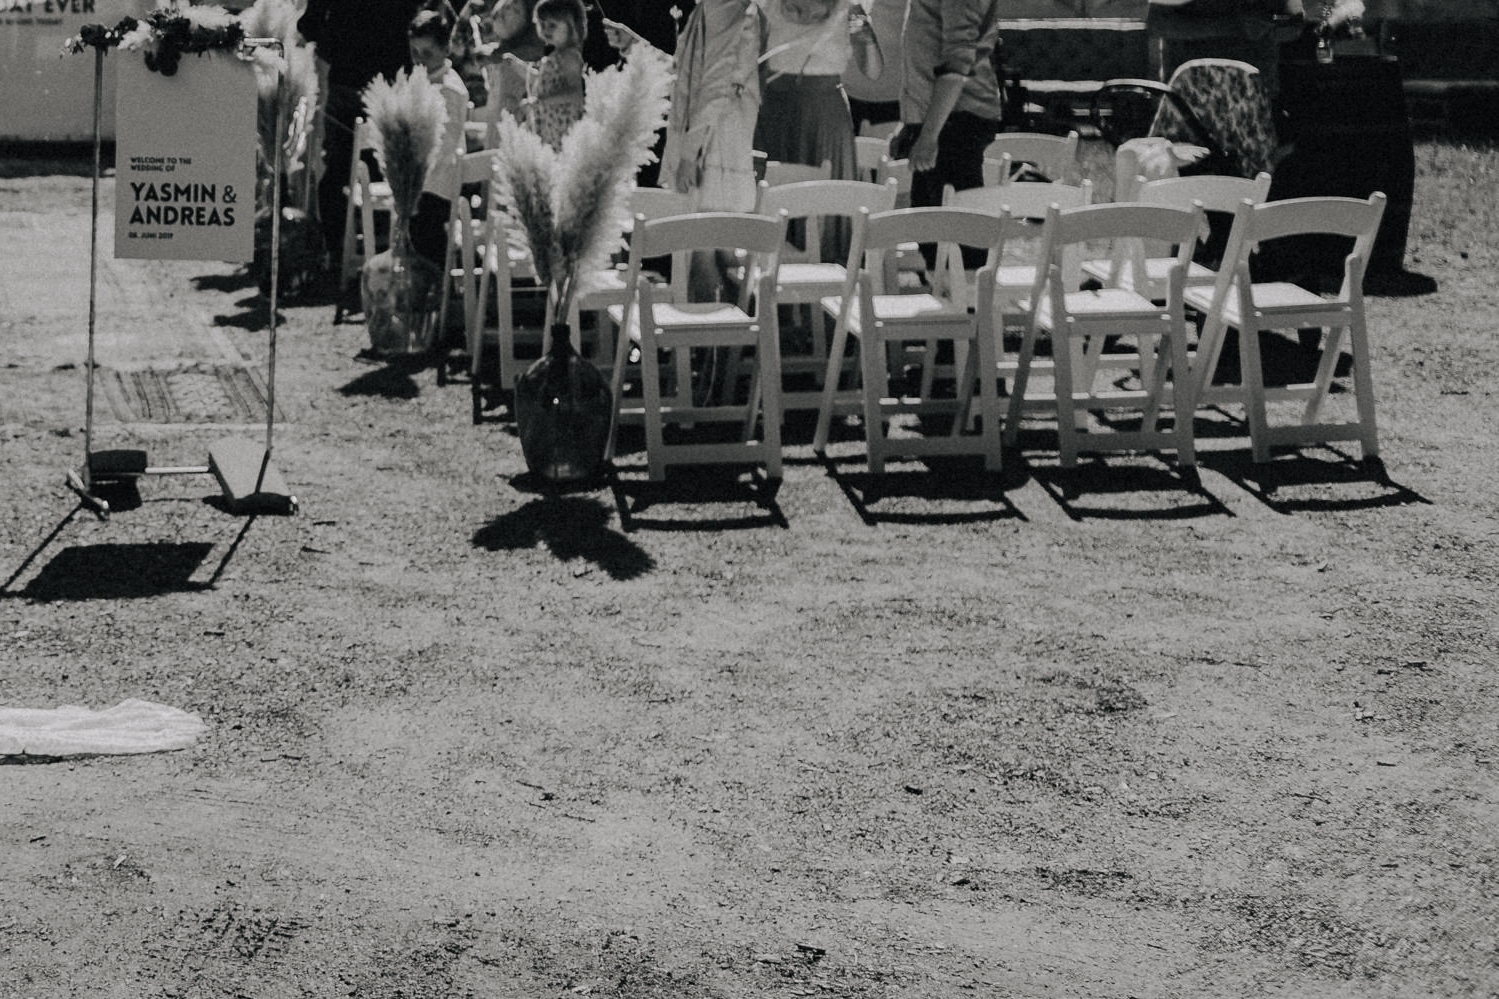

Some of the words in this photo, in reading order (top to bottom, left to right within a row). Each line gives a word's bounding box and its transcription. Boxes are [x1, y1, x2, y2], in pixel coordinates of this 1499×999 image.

[130, 182, 216, 203] YASMIN
[222, 185, 237, 204] &
[129, 206, 236, 226] ANDREAS
